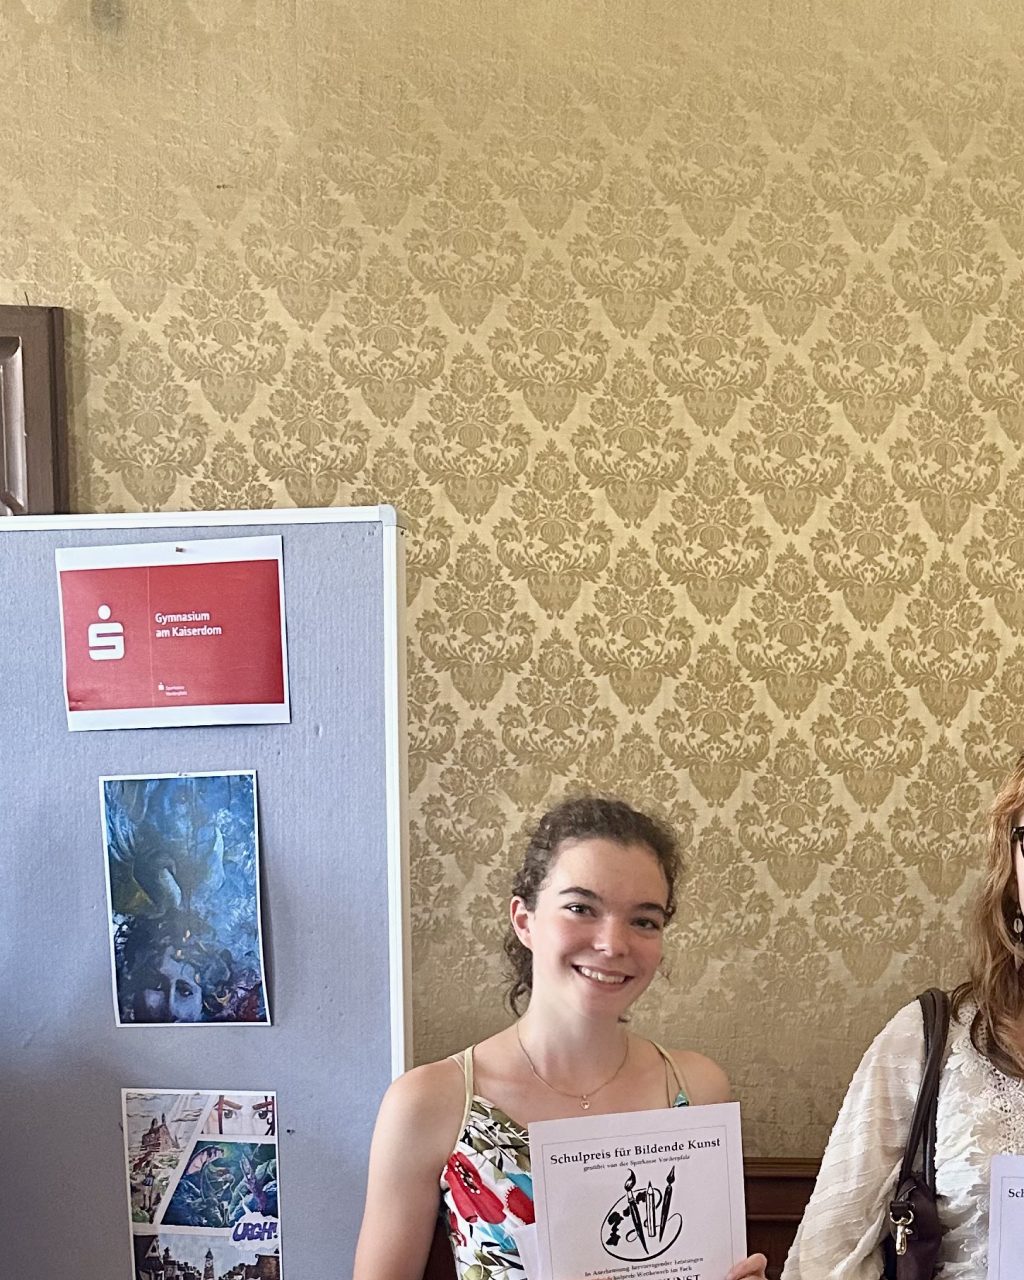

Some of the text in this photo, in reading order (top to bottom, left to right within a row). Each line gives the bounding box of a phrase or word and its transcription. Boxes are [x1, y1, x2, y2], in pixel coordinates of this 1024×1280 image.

[155, 611, 210, 625] Gymnasium
[155, 625, 222, 638] am Kaiserdom
[550, 1138, 721, 1165] Schulpreis für Bildende Kunst
[232, 1221, 278, 1241] URGH!
